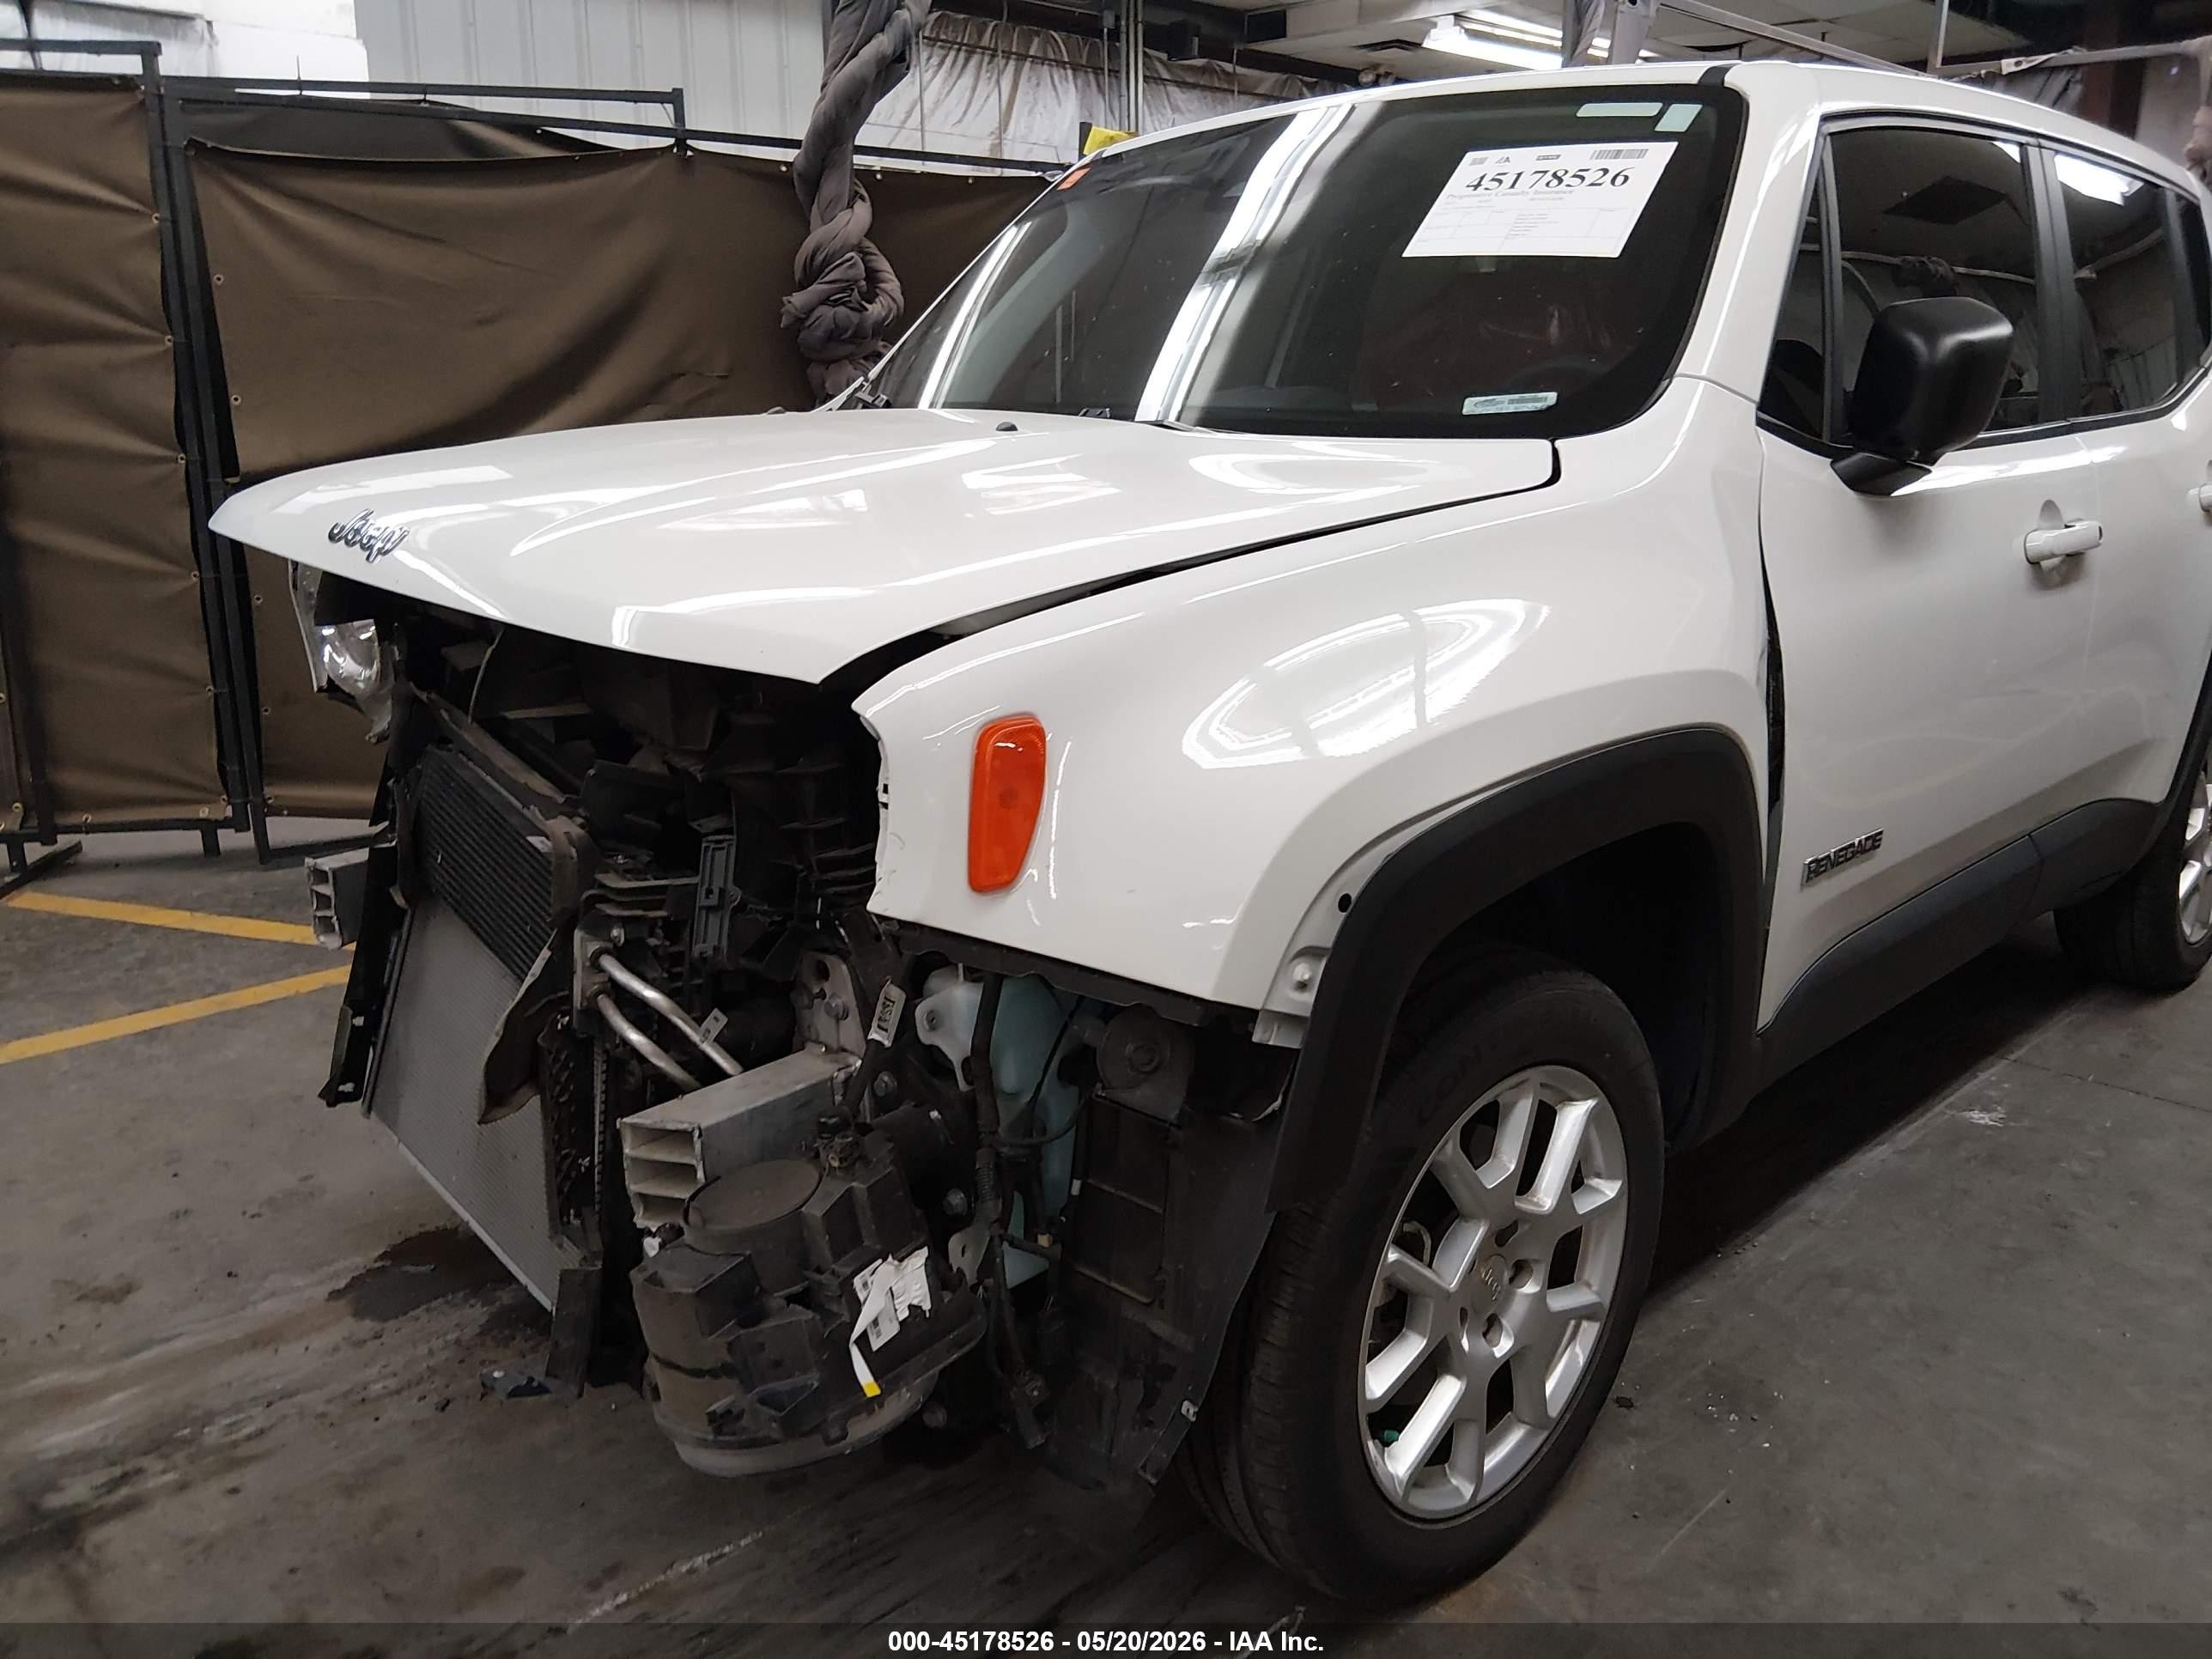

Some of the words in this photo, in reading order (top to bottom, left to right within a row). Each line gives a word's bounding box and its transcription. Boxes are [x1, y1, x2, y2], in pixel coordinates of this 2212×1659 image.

[1466, 167, 1634, 191] 45178526
[328, 508, 410, 563] Jeep
[1801, 828, 1883, 884] RENEGADE
